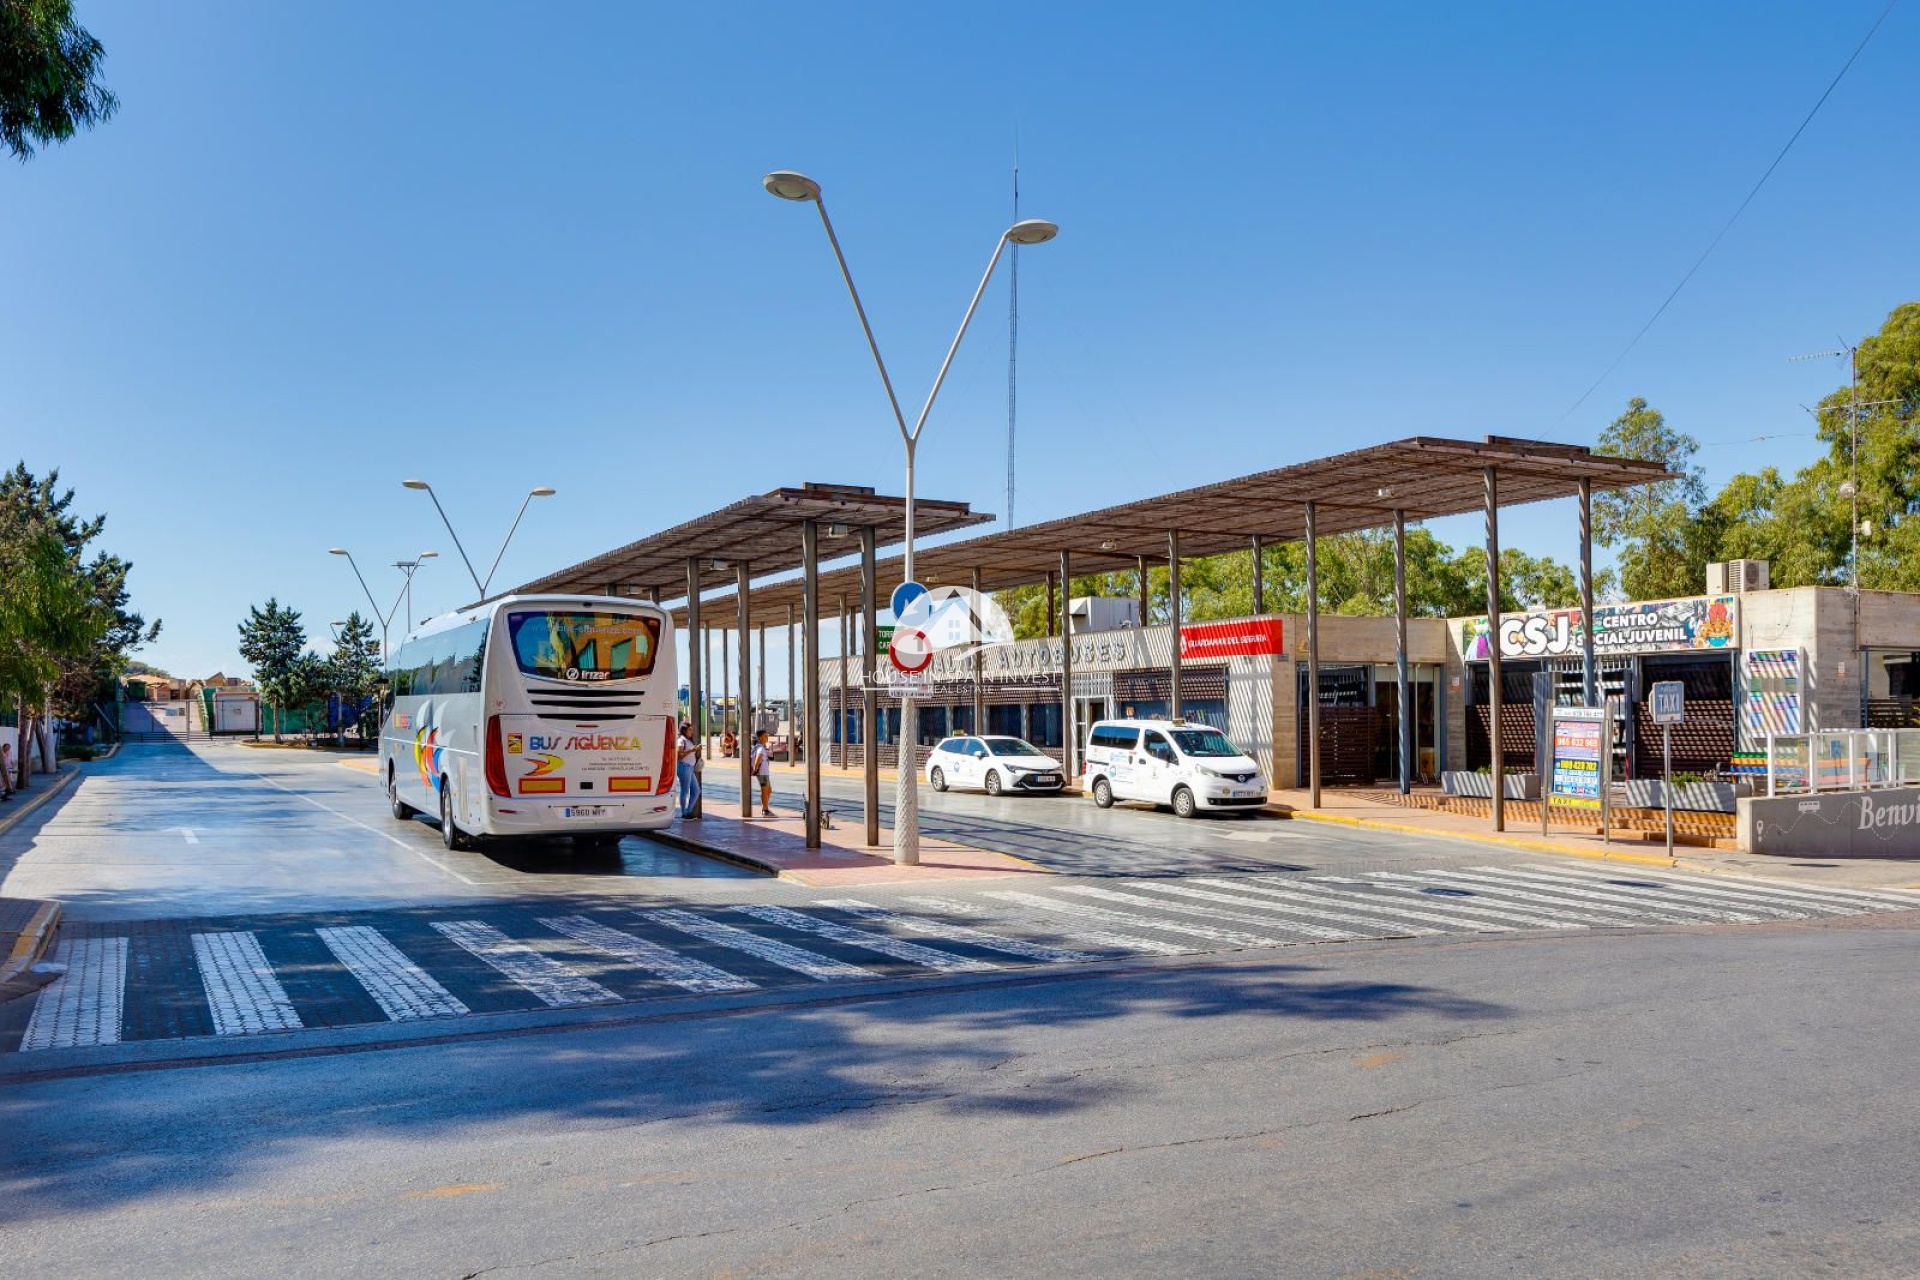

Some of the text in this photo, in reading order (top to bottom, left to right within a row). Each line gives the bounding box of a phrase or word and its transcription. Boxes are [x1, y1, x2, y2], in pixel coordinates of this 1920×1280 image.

[1602, 612, 1658, 628] CENTRO
[1188, 634, 1267, 649] GUARDAMAR DEL SEGURA
[1500, 614, 1569, 656] CSJ
[1576, 627, 1687, 647] SCIAL JUVENIL
[998, 640, 1125, 668] AUTOBUSES
[1658, 693, 1680, 713] TAXI
[530, 735, 562, 751] BUS
